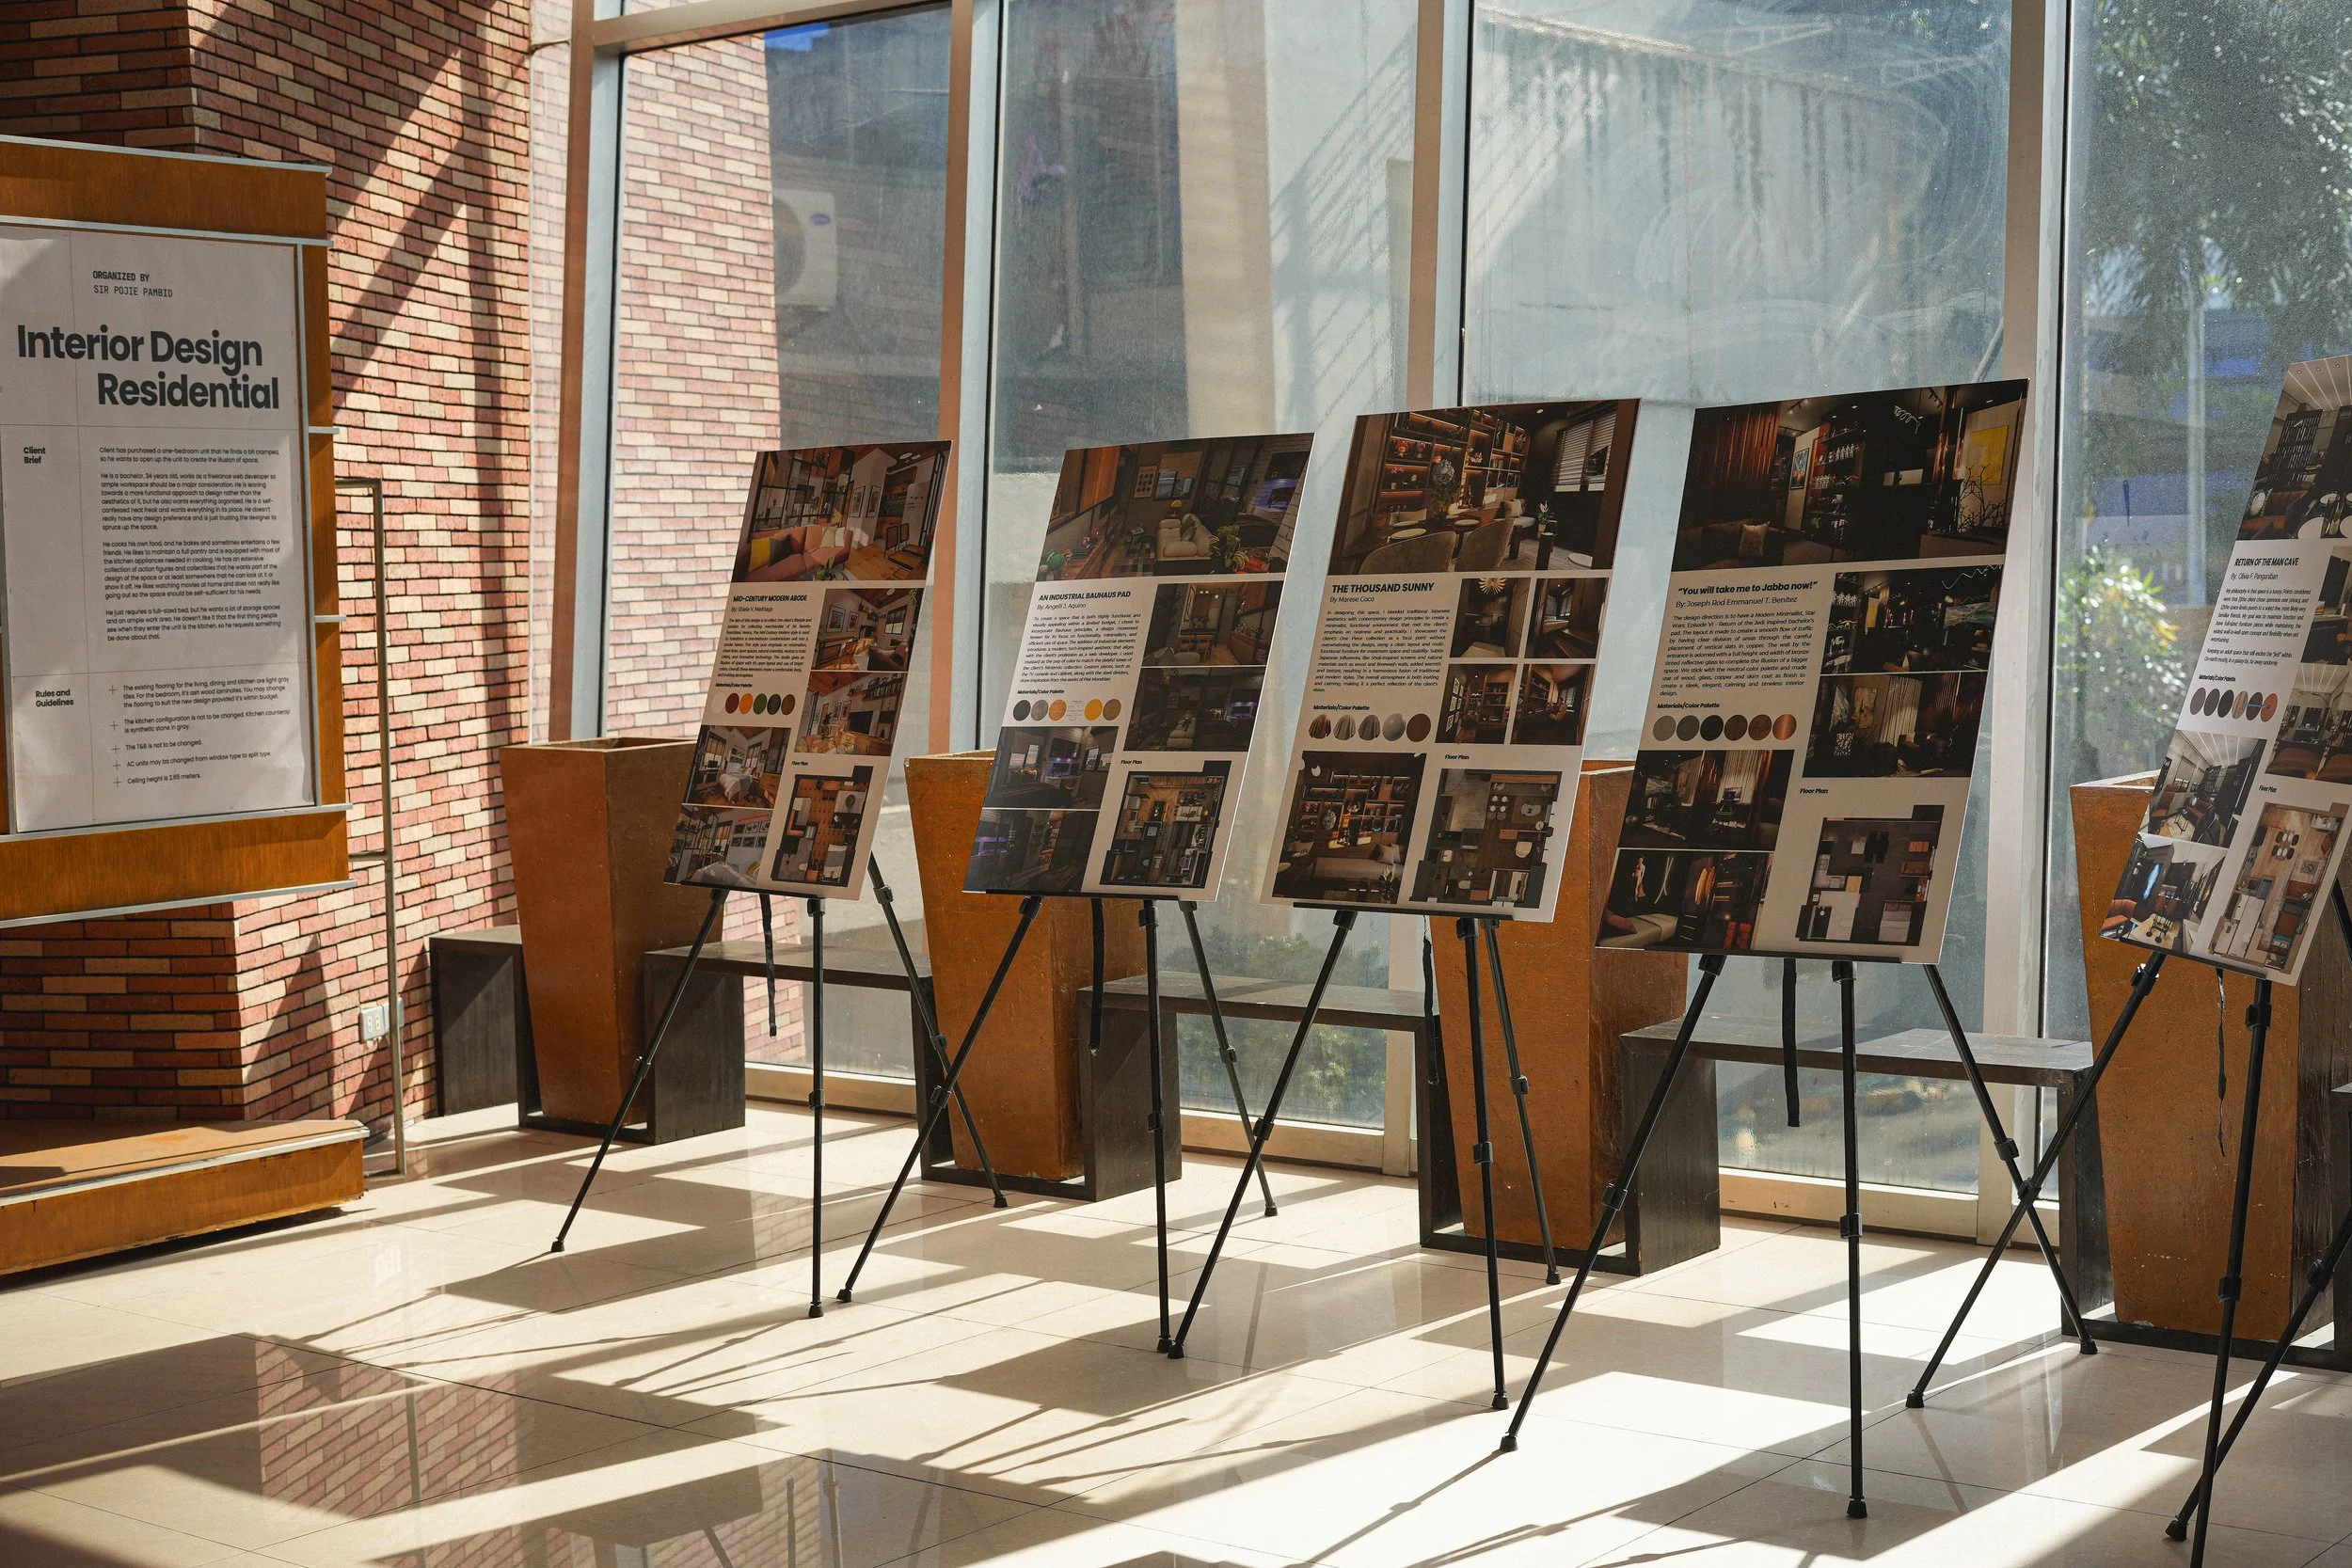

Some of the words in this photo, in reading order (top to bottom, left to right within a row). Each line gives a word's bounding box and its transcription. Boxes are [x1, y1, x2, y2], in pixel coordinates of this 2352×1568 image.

[92, 271, 136, 281] ORGANIZED
[139, 273, 150, 282] BY
[93, 285, 109, 293] SIR
[114, 286, 138, 295] POJIE
[143, 288, 173, 297] PAMBID
[17, 324, 144, 361] Interior
[150, 329, 262, 376] Design
[97, 371, 279, 409] Residential
[24, 446, 46, 454] Client
[1332, 584, 1349, 594] THE
[1350, 583, 1401, 593] THOUSAND
[1402, 582, 1435, 592] SUNNY
[1762, 583, 1790, 591] Jabba
[1049, 593, 1085, 601] INDUSTRIAL
[35, 698, 74, 707] Guidelines
